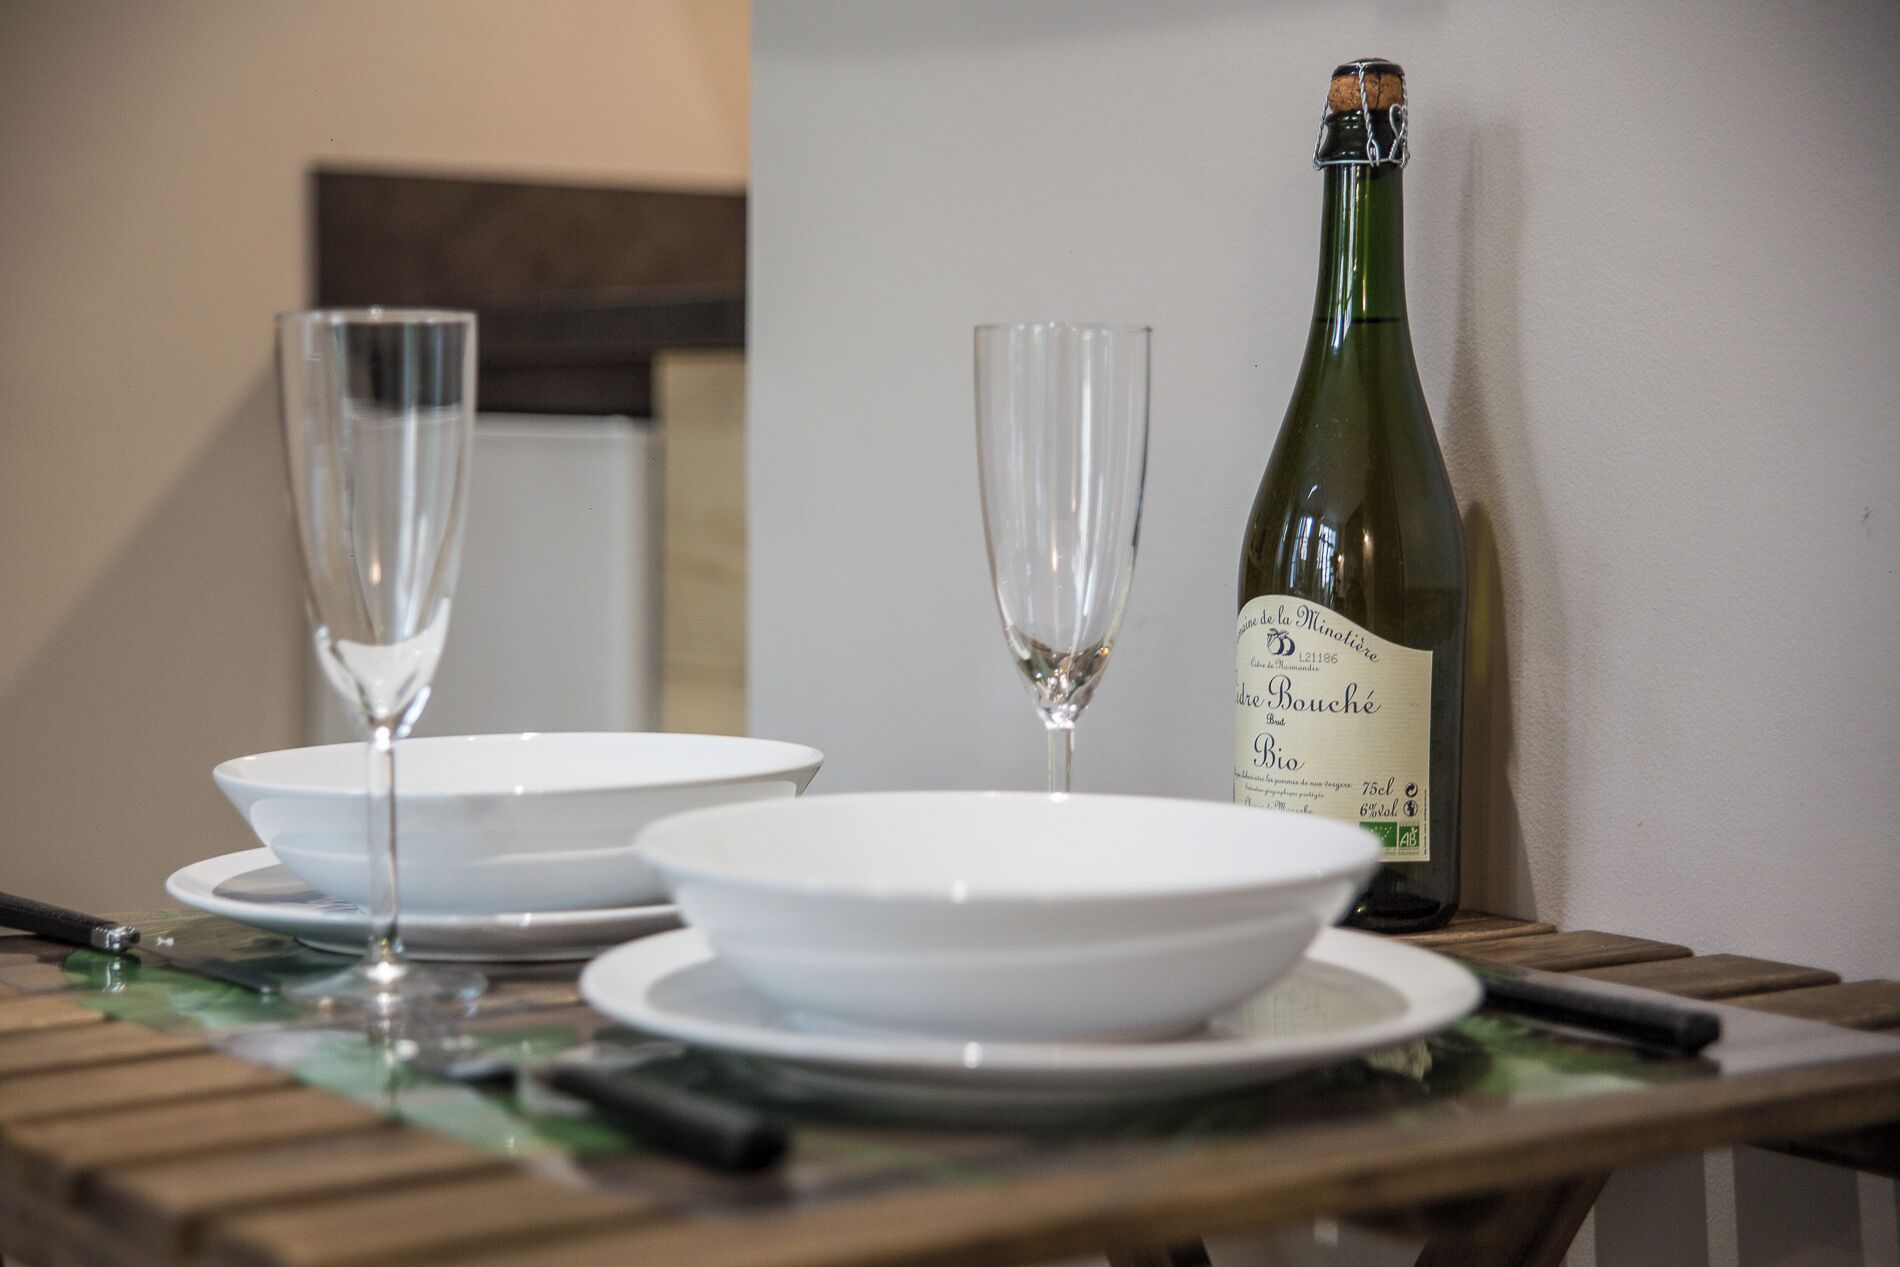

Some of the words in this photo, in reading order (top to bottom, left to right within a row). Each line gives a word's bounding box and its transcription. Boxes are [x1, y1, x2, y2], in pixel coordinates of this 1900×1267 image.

[1260, 608, 1275, 625] de
[1278, 604, 1293, 626] la
[1295, 604, 1380, 663] Minotière
[1266, 661, 1274, 669] de
[1275, 659, 1321, 672] Normandie
[1299, 651, 1338, 664] L21186
[1236, 682, 1265, 708] idre
[1267, 674, 1381, 714] Bouché
[1266, 712, 1287, 726] Brut
[1253, 732, 1306, 771] Bio
[1362, 776, 1395, 796] 75cl
[1400, 827, 1418, 847] AB
